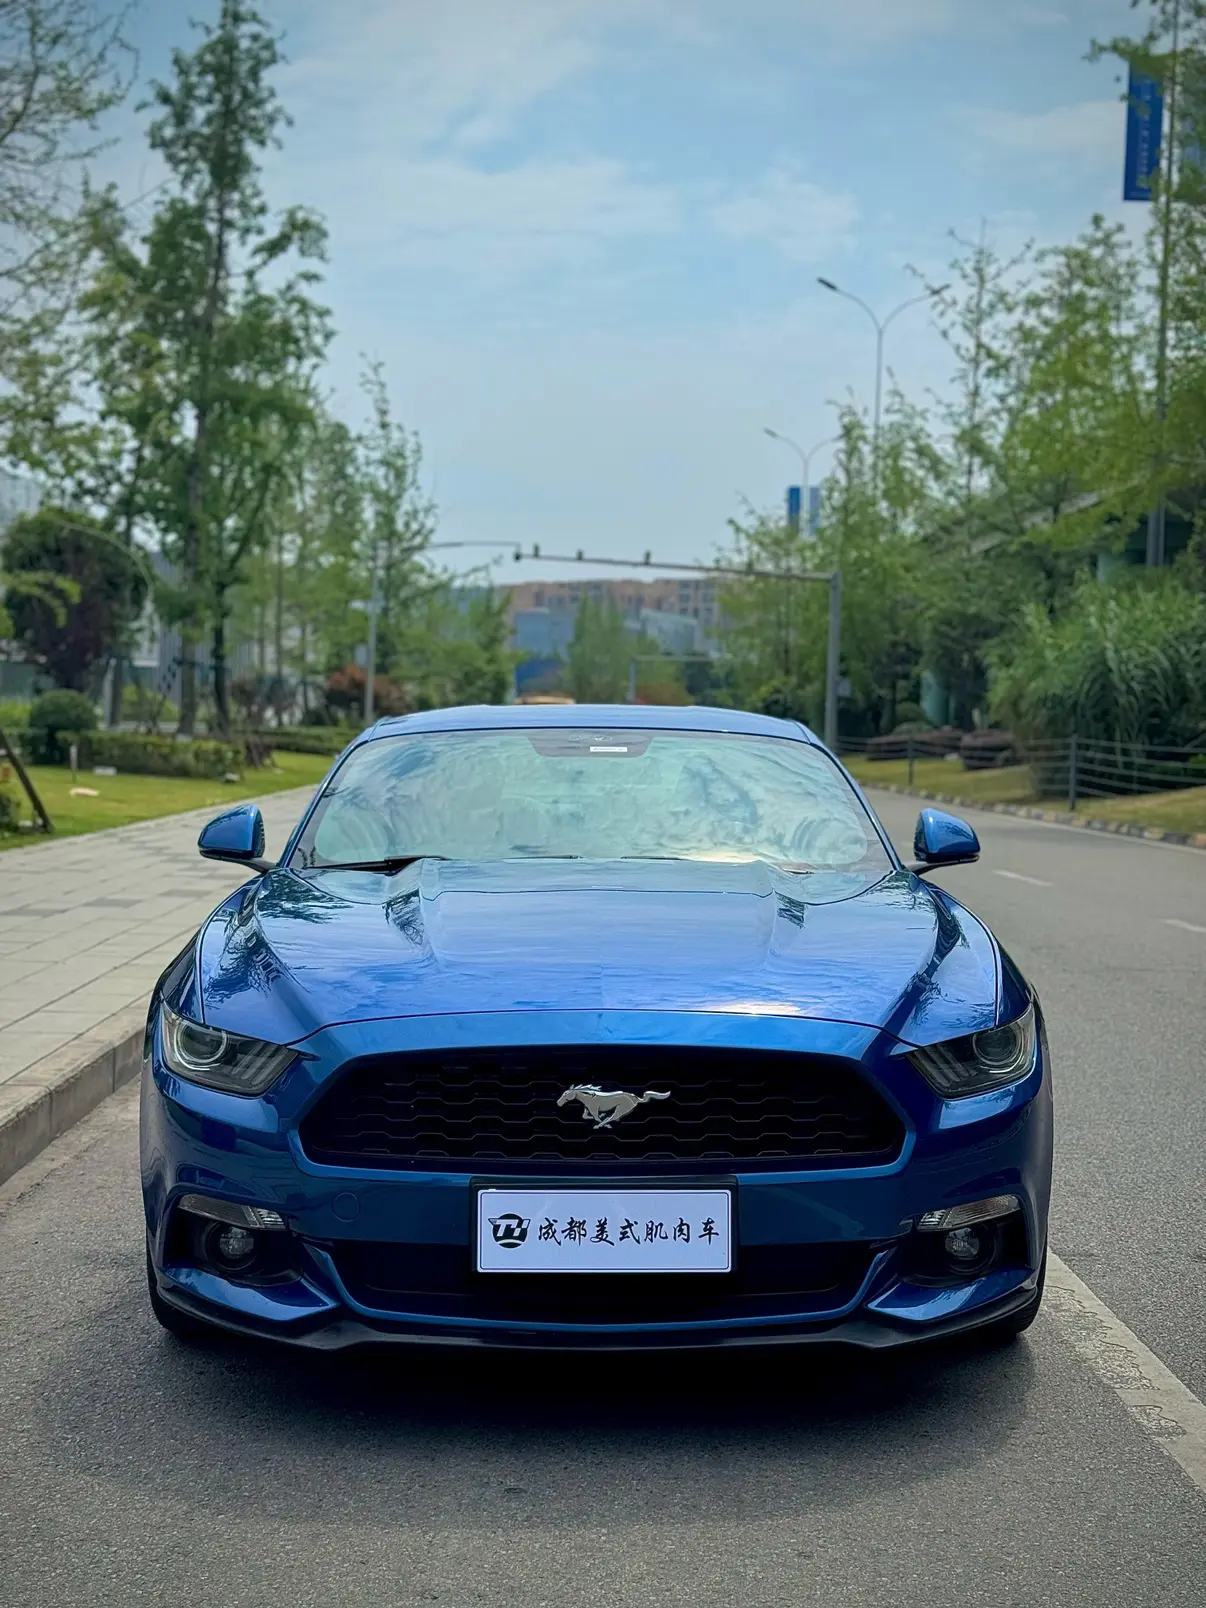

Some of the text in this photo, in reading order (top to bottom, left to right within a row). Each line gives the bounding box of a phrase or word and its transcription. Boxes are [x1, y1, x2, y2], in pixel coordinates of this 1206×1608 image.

[538, 1216, 720, 1247] 成都美式肌肉车
